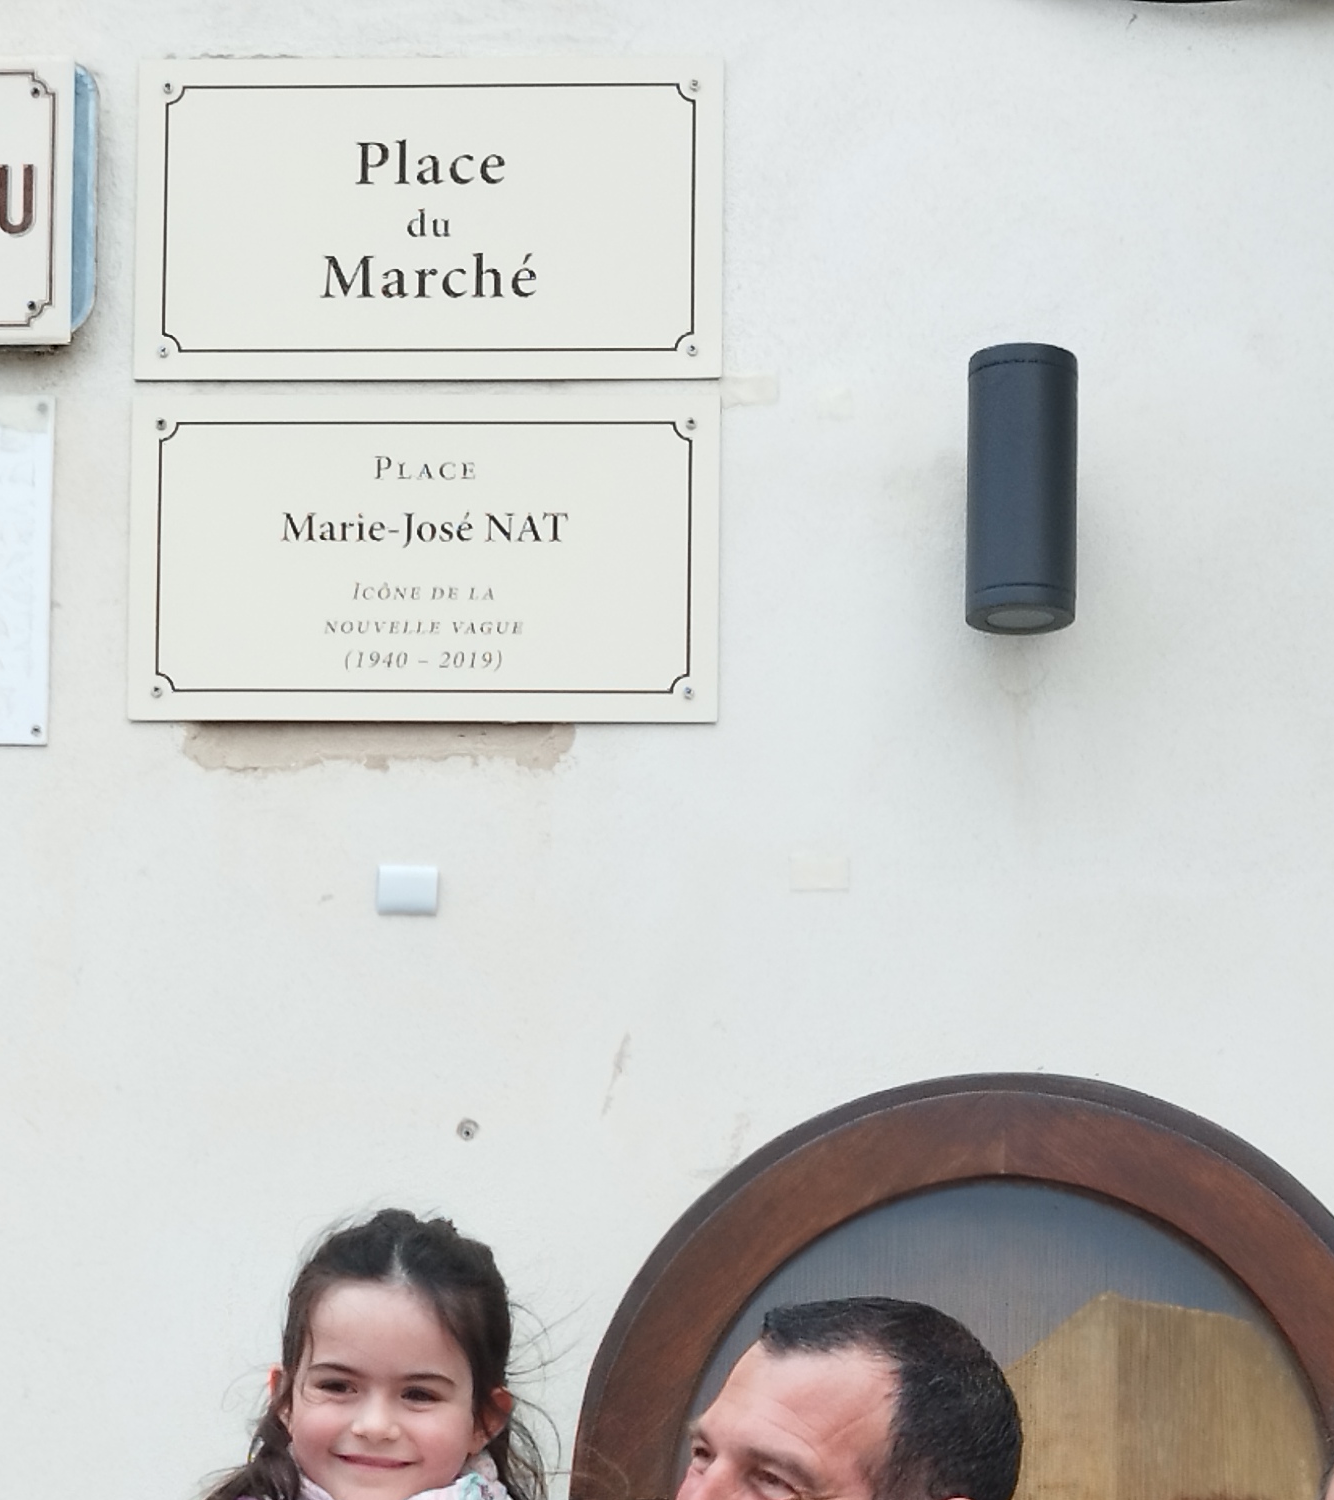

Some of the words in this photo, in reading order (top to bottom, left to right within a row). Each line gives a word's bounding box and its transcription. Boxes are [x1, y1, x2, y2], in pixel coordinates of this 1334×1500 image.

[355, 139, 507, 186] Place
[405, 208, 451, 238] du
[319, 252, 538, 300] Marché
[373, 455, 477, 481] PLACE
[280, 510, 473, 548] Marie-José
[484, 512, 570, 543] NAT
[430, 586, 460, 602] DE
[467, 586, 496, 602] LA
[323, 620, 441, 636] NOUVELLE
[451, 620, 523, 636] VAGUE
[343, 650, 409, 672] (1940
[438, 650, 504, 672] 2019)
